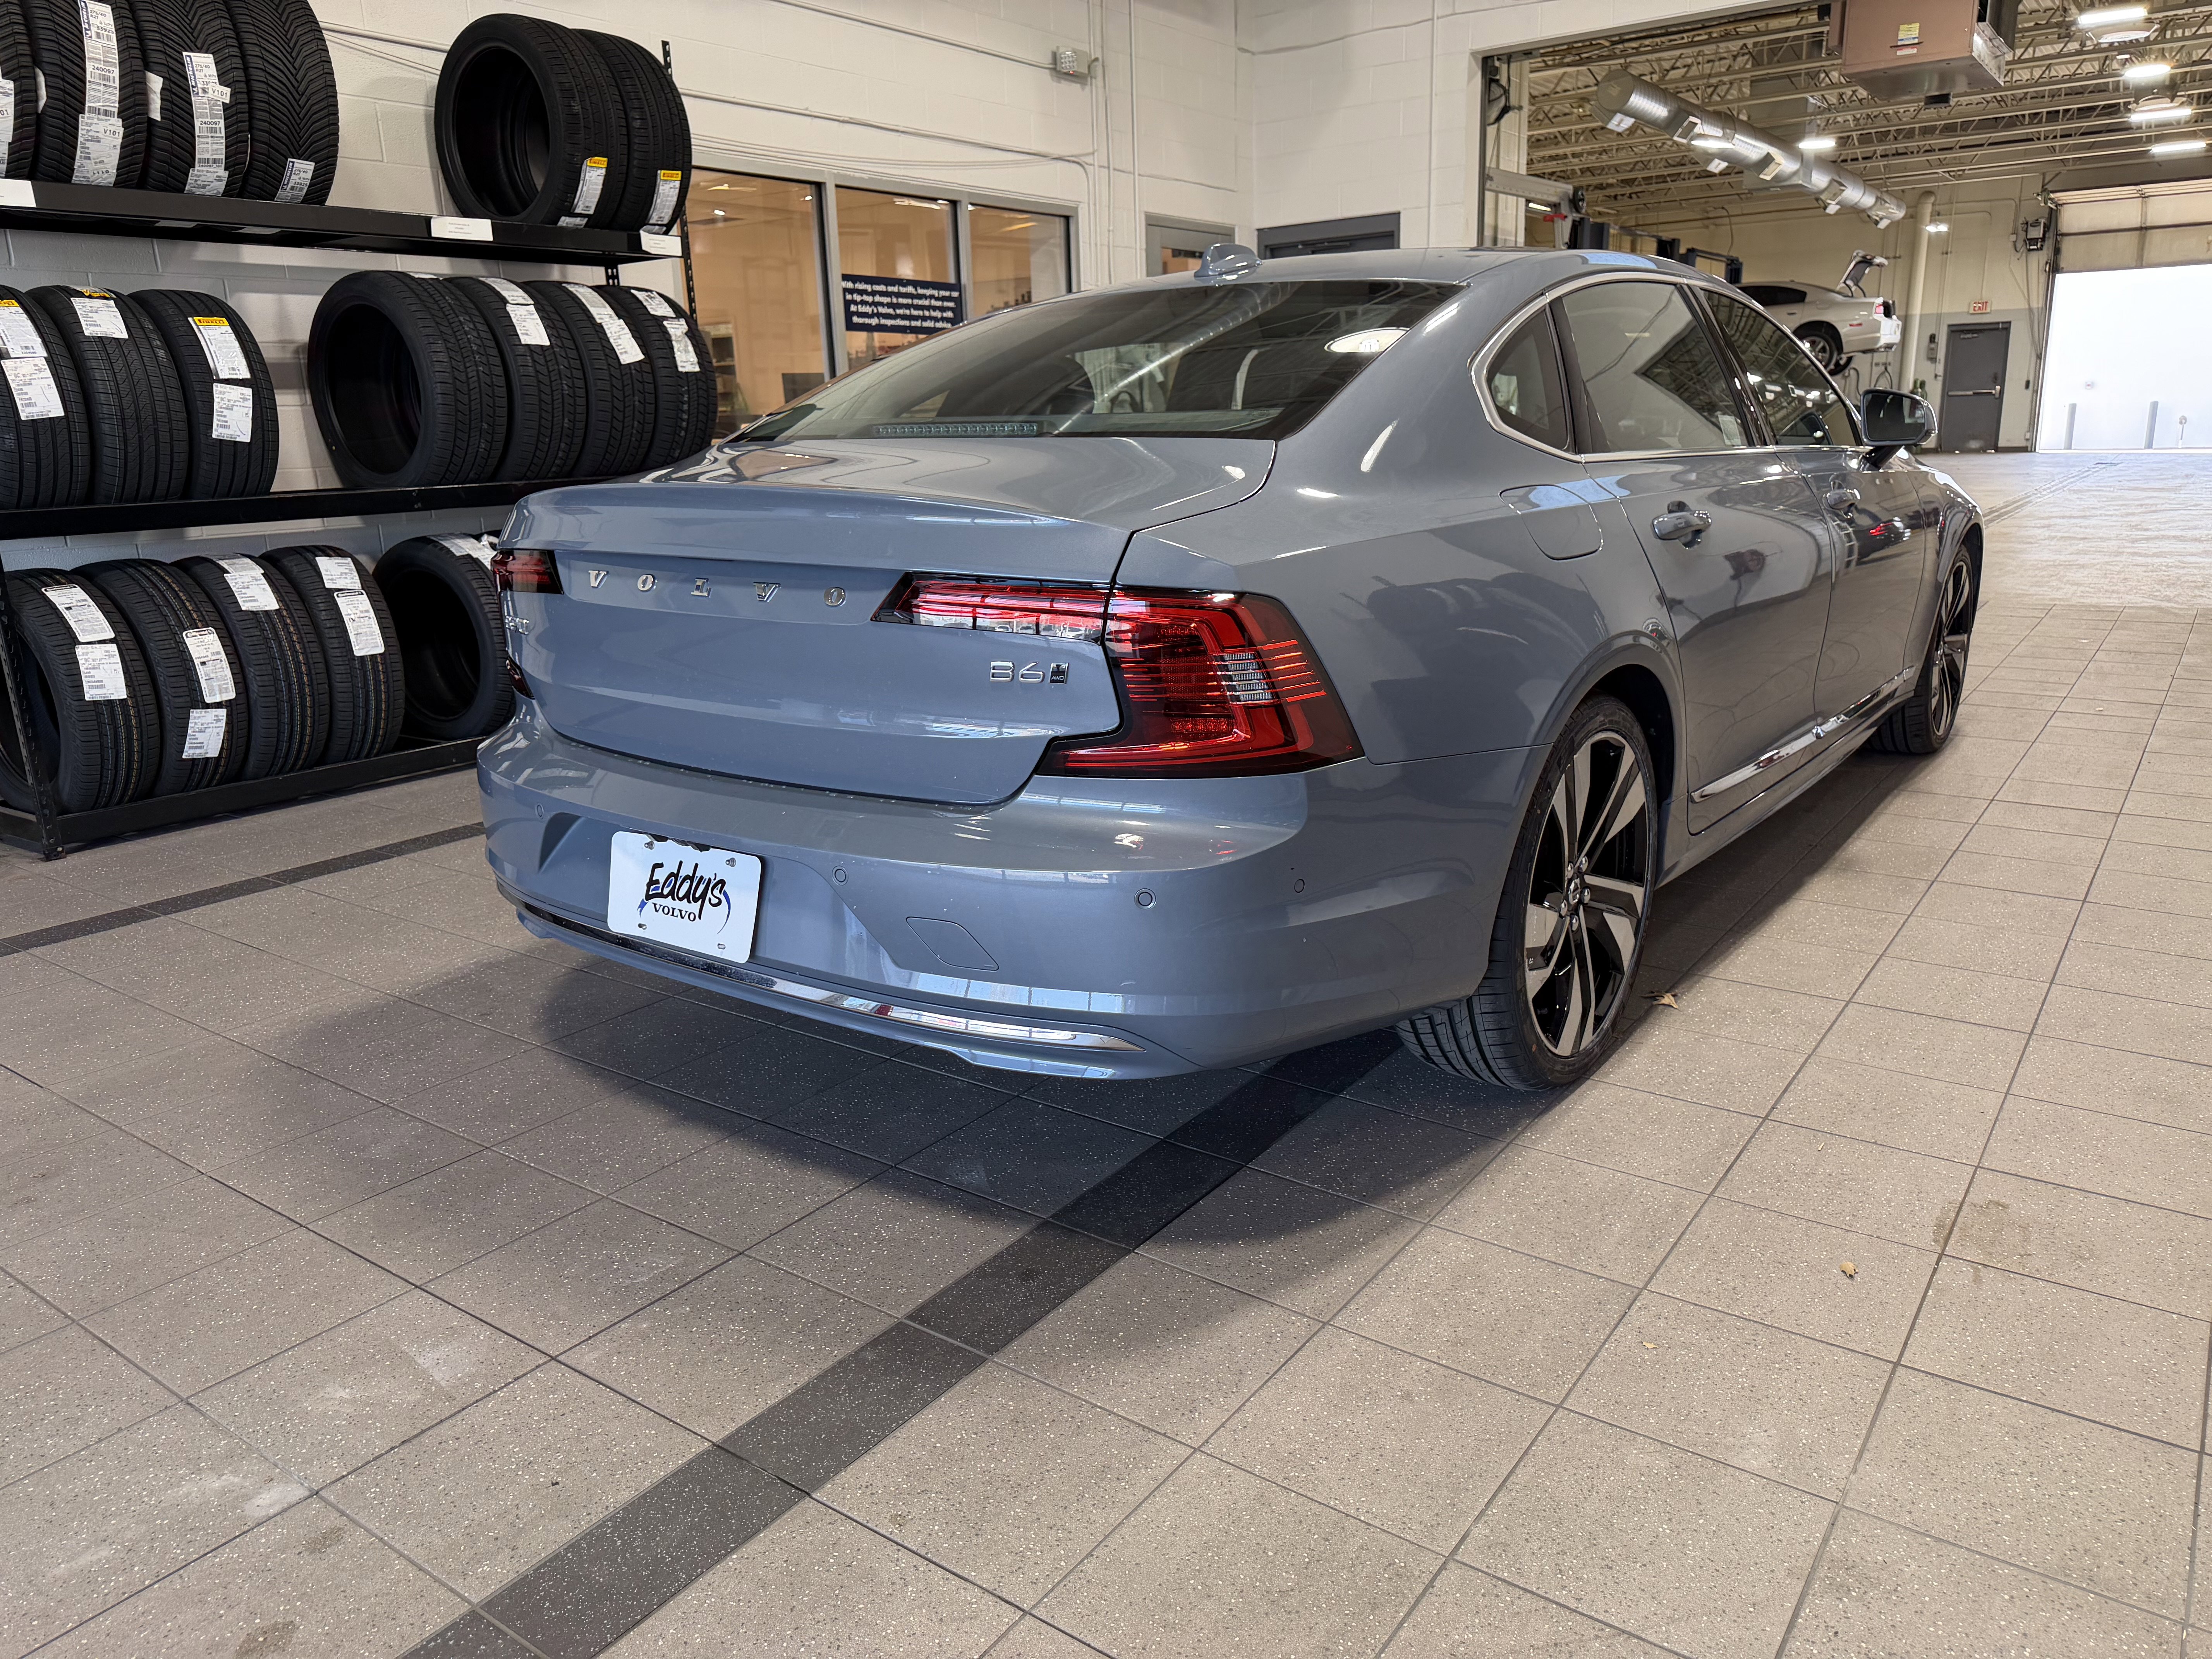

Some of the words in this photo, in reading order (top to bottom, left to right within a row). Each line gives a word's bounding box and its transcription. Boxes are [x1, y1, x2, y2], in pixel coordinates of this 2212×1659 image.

[92, 65, 115, 74] 240097
[212, 88, 227, 98] V101
[104, 129, 120, 137] V101
[1973, 301, 1989, 312] EXIT
[588, 570, 847, 607] VOLVO
[989, 661, 1045, 683] B6
[644, 860, 726, 920] Eddy's
[652, 903, 696, 922] VOLVO
